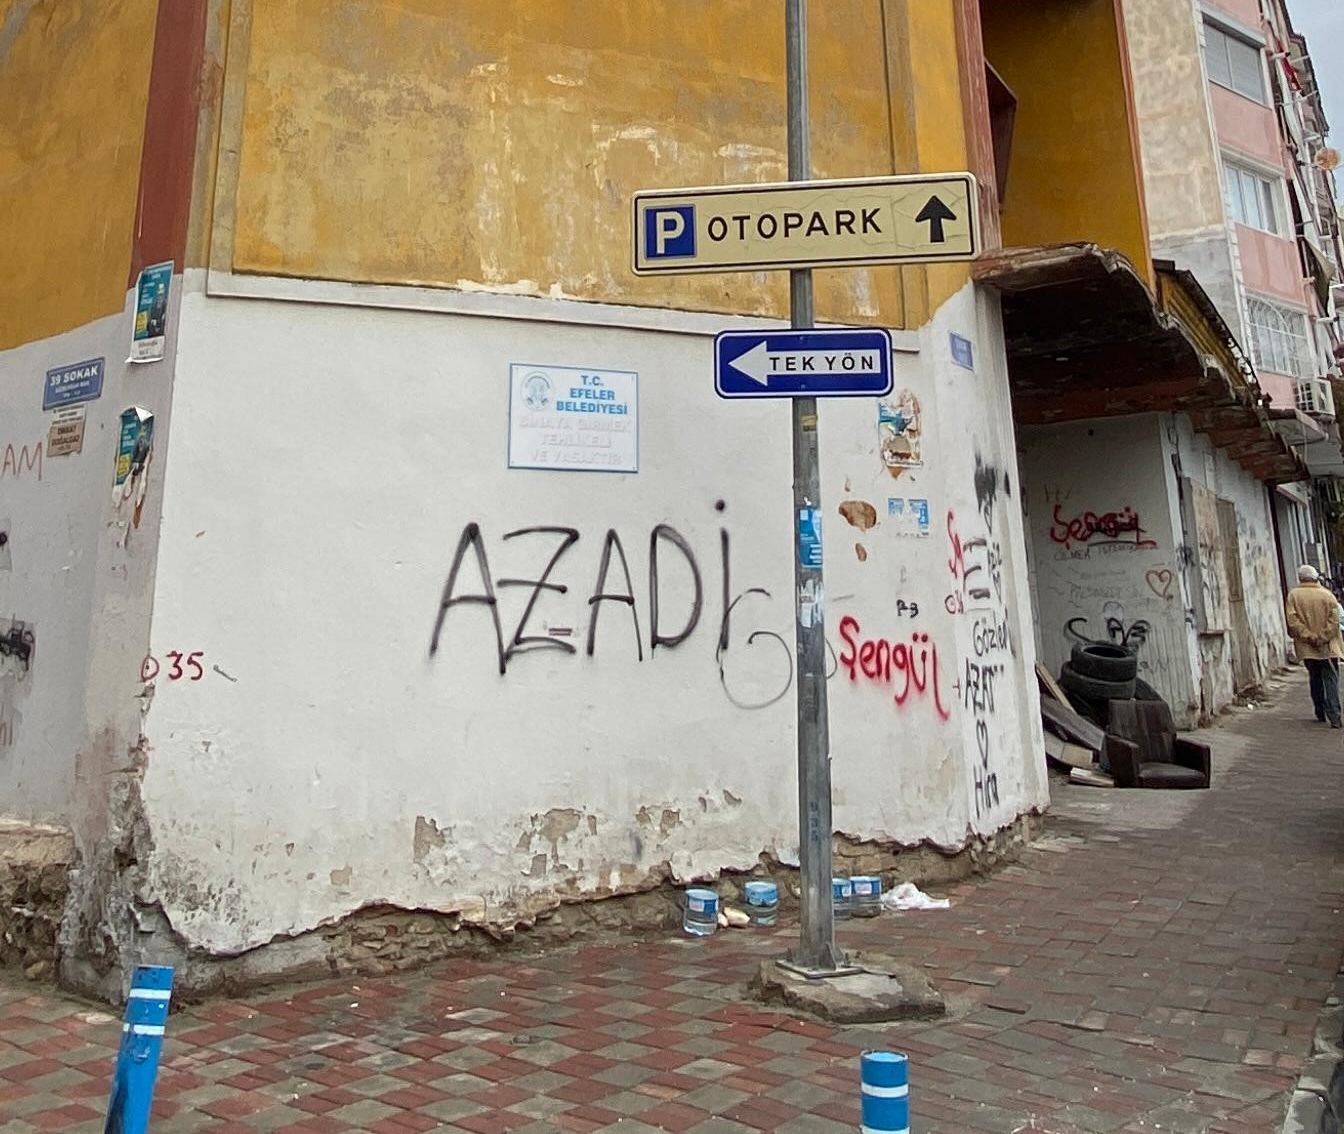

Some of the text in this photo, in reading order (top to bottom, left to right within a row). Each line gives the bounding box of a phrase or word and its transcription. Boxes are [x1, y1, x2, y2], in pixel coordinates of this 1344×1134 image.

[707, 208, 882, 242] OTOPARK
[769, 352, 874, 372] TEK YÖN
[49, 365, 98, 387] 39 SOKAK
[581, 375, 604, 387] T.C.
[570, 388, 615, 401] EFELER
[556, 401, 628, 415] BELEDİYESİ
[839, 616, 950, 721] Şengül
